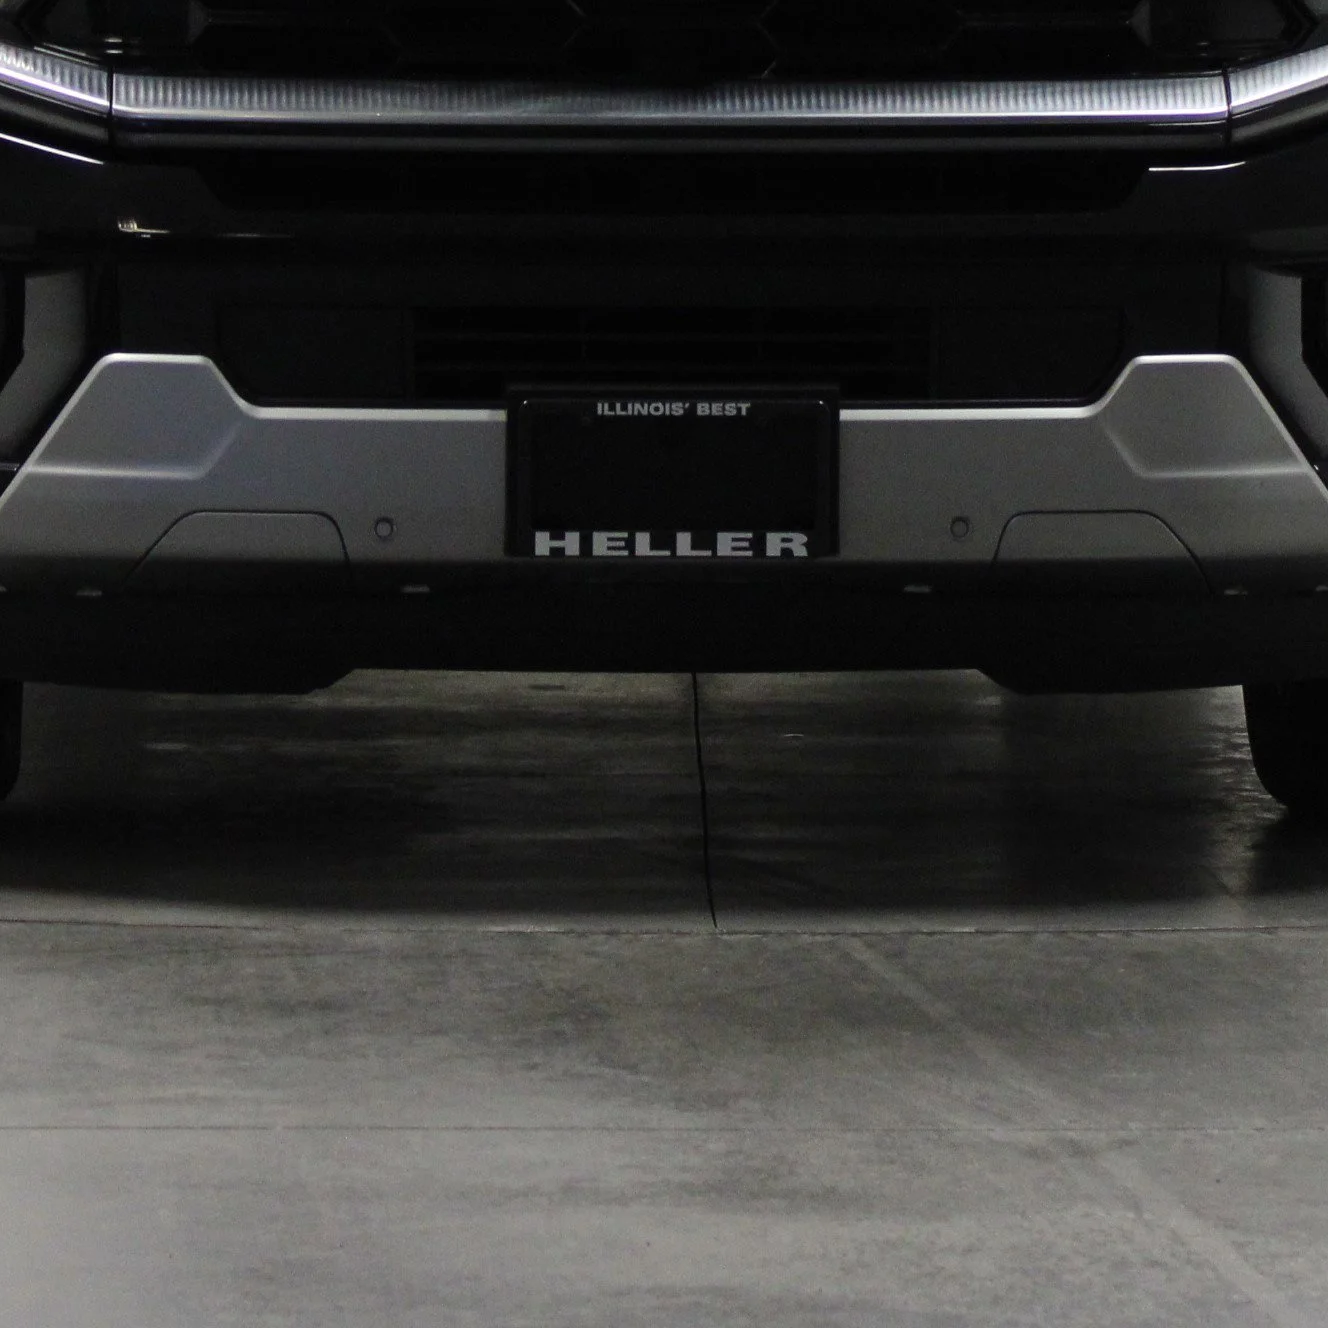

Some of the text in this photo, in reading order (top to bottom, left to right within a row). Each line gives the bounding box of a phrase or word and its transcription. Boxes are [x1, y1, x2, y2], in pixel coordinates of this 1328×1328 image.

[596, 402, 751, 416] ILLINOIS' BEST
[534, 531, 809, 556] HELLER
